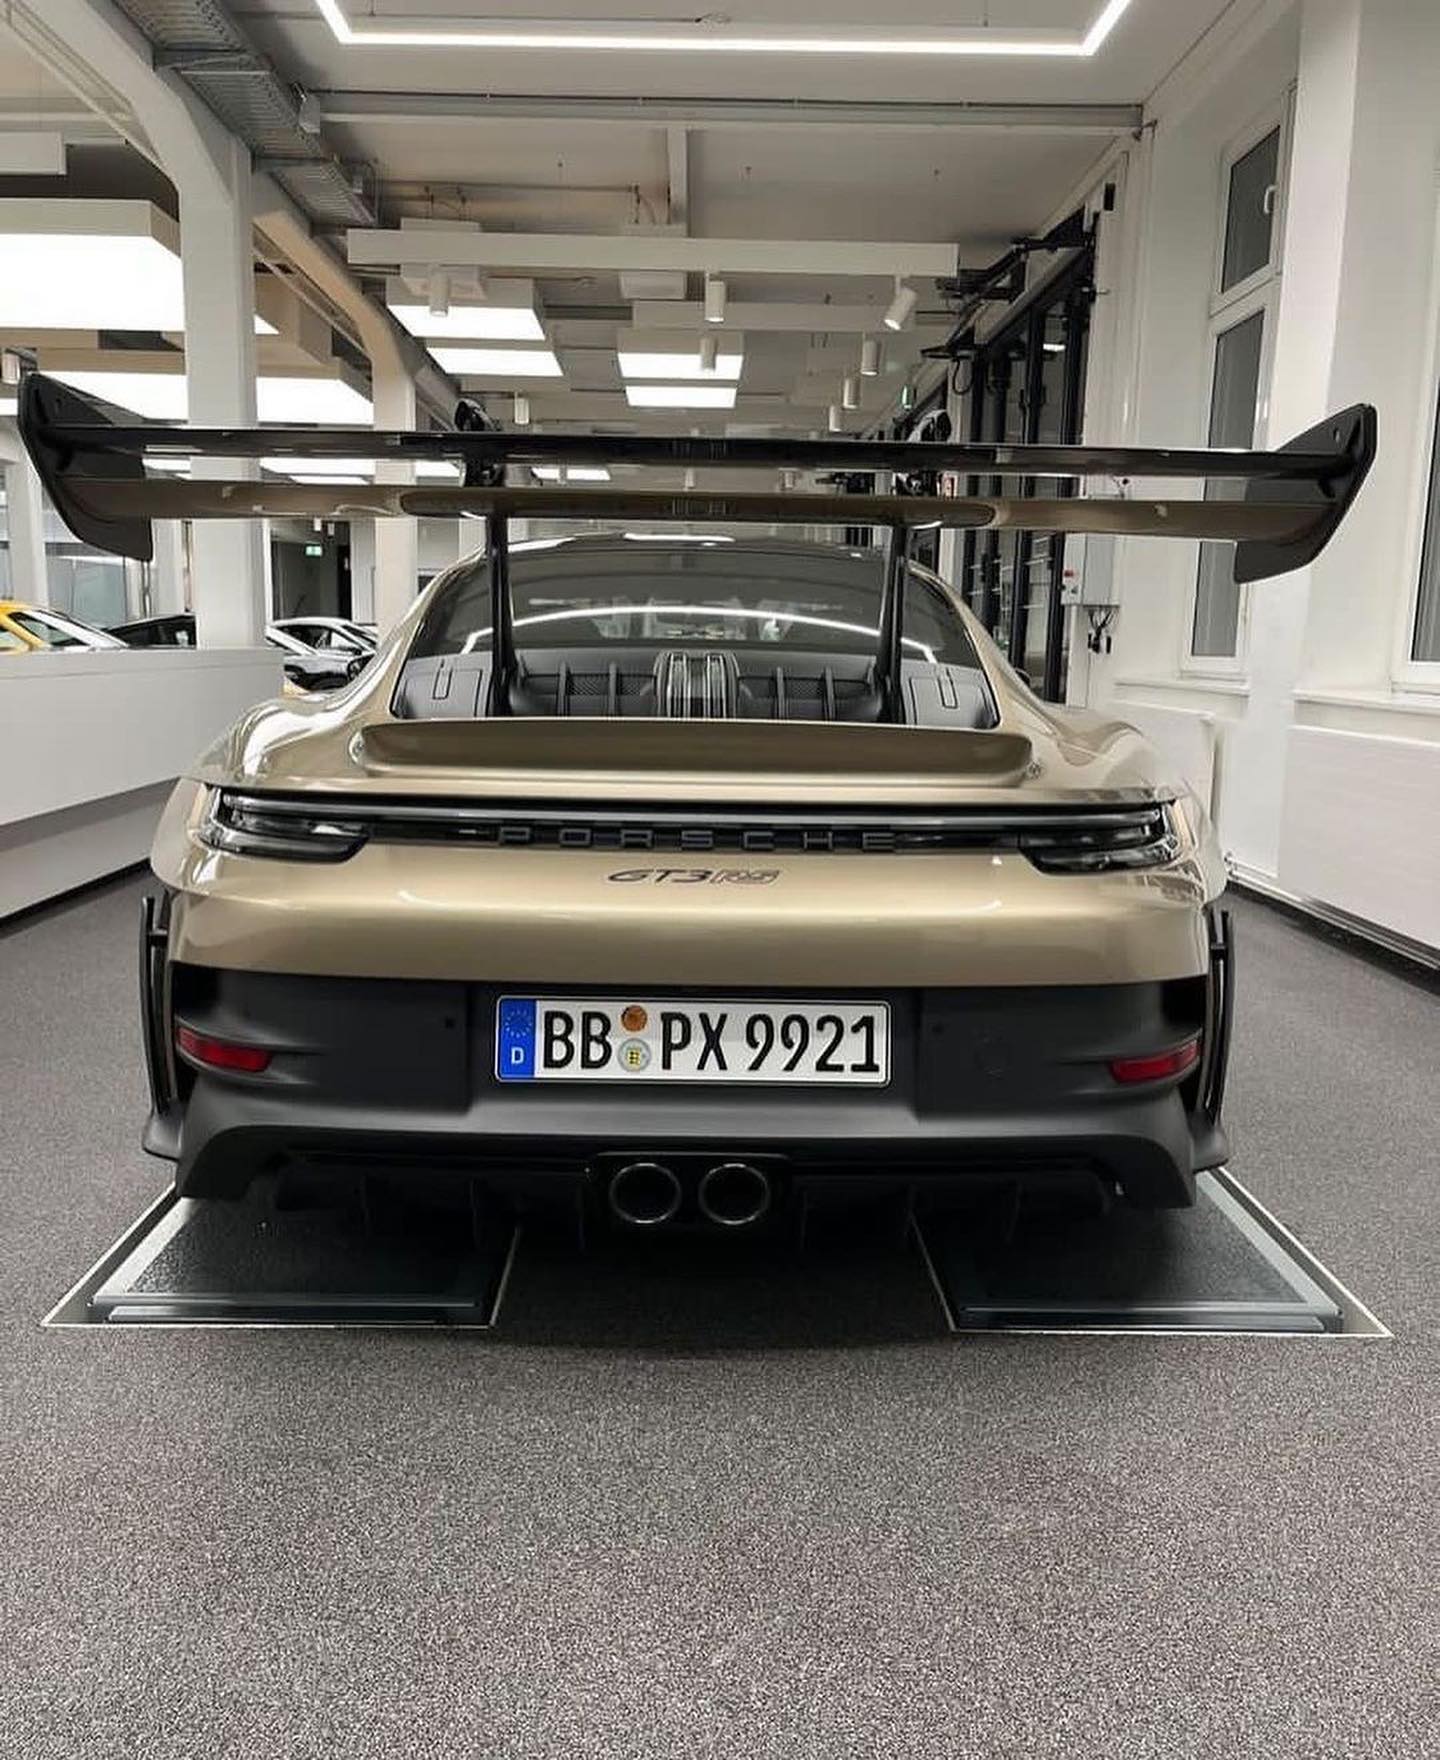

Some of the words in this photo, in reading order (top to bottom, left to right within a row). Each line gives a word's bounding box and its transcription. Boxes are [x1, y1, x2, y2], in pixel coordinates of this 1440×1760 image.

[501, 826, 896, 850] PORSCHE
[543, 1010, 612, 1069] BB
[660, 1013, 729, 1071] PX
[745, 1014, 880, 1072] 9921
[510, 1048, 525, 1064] D
